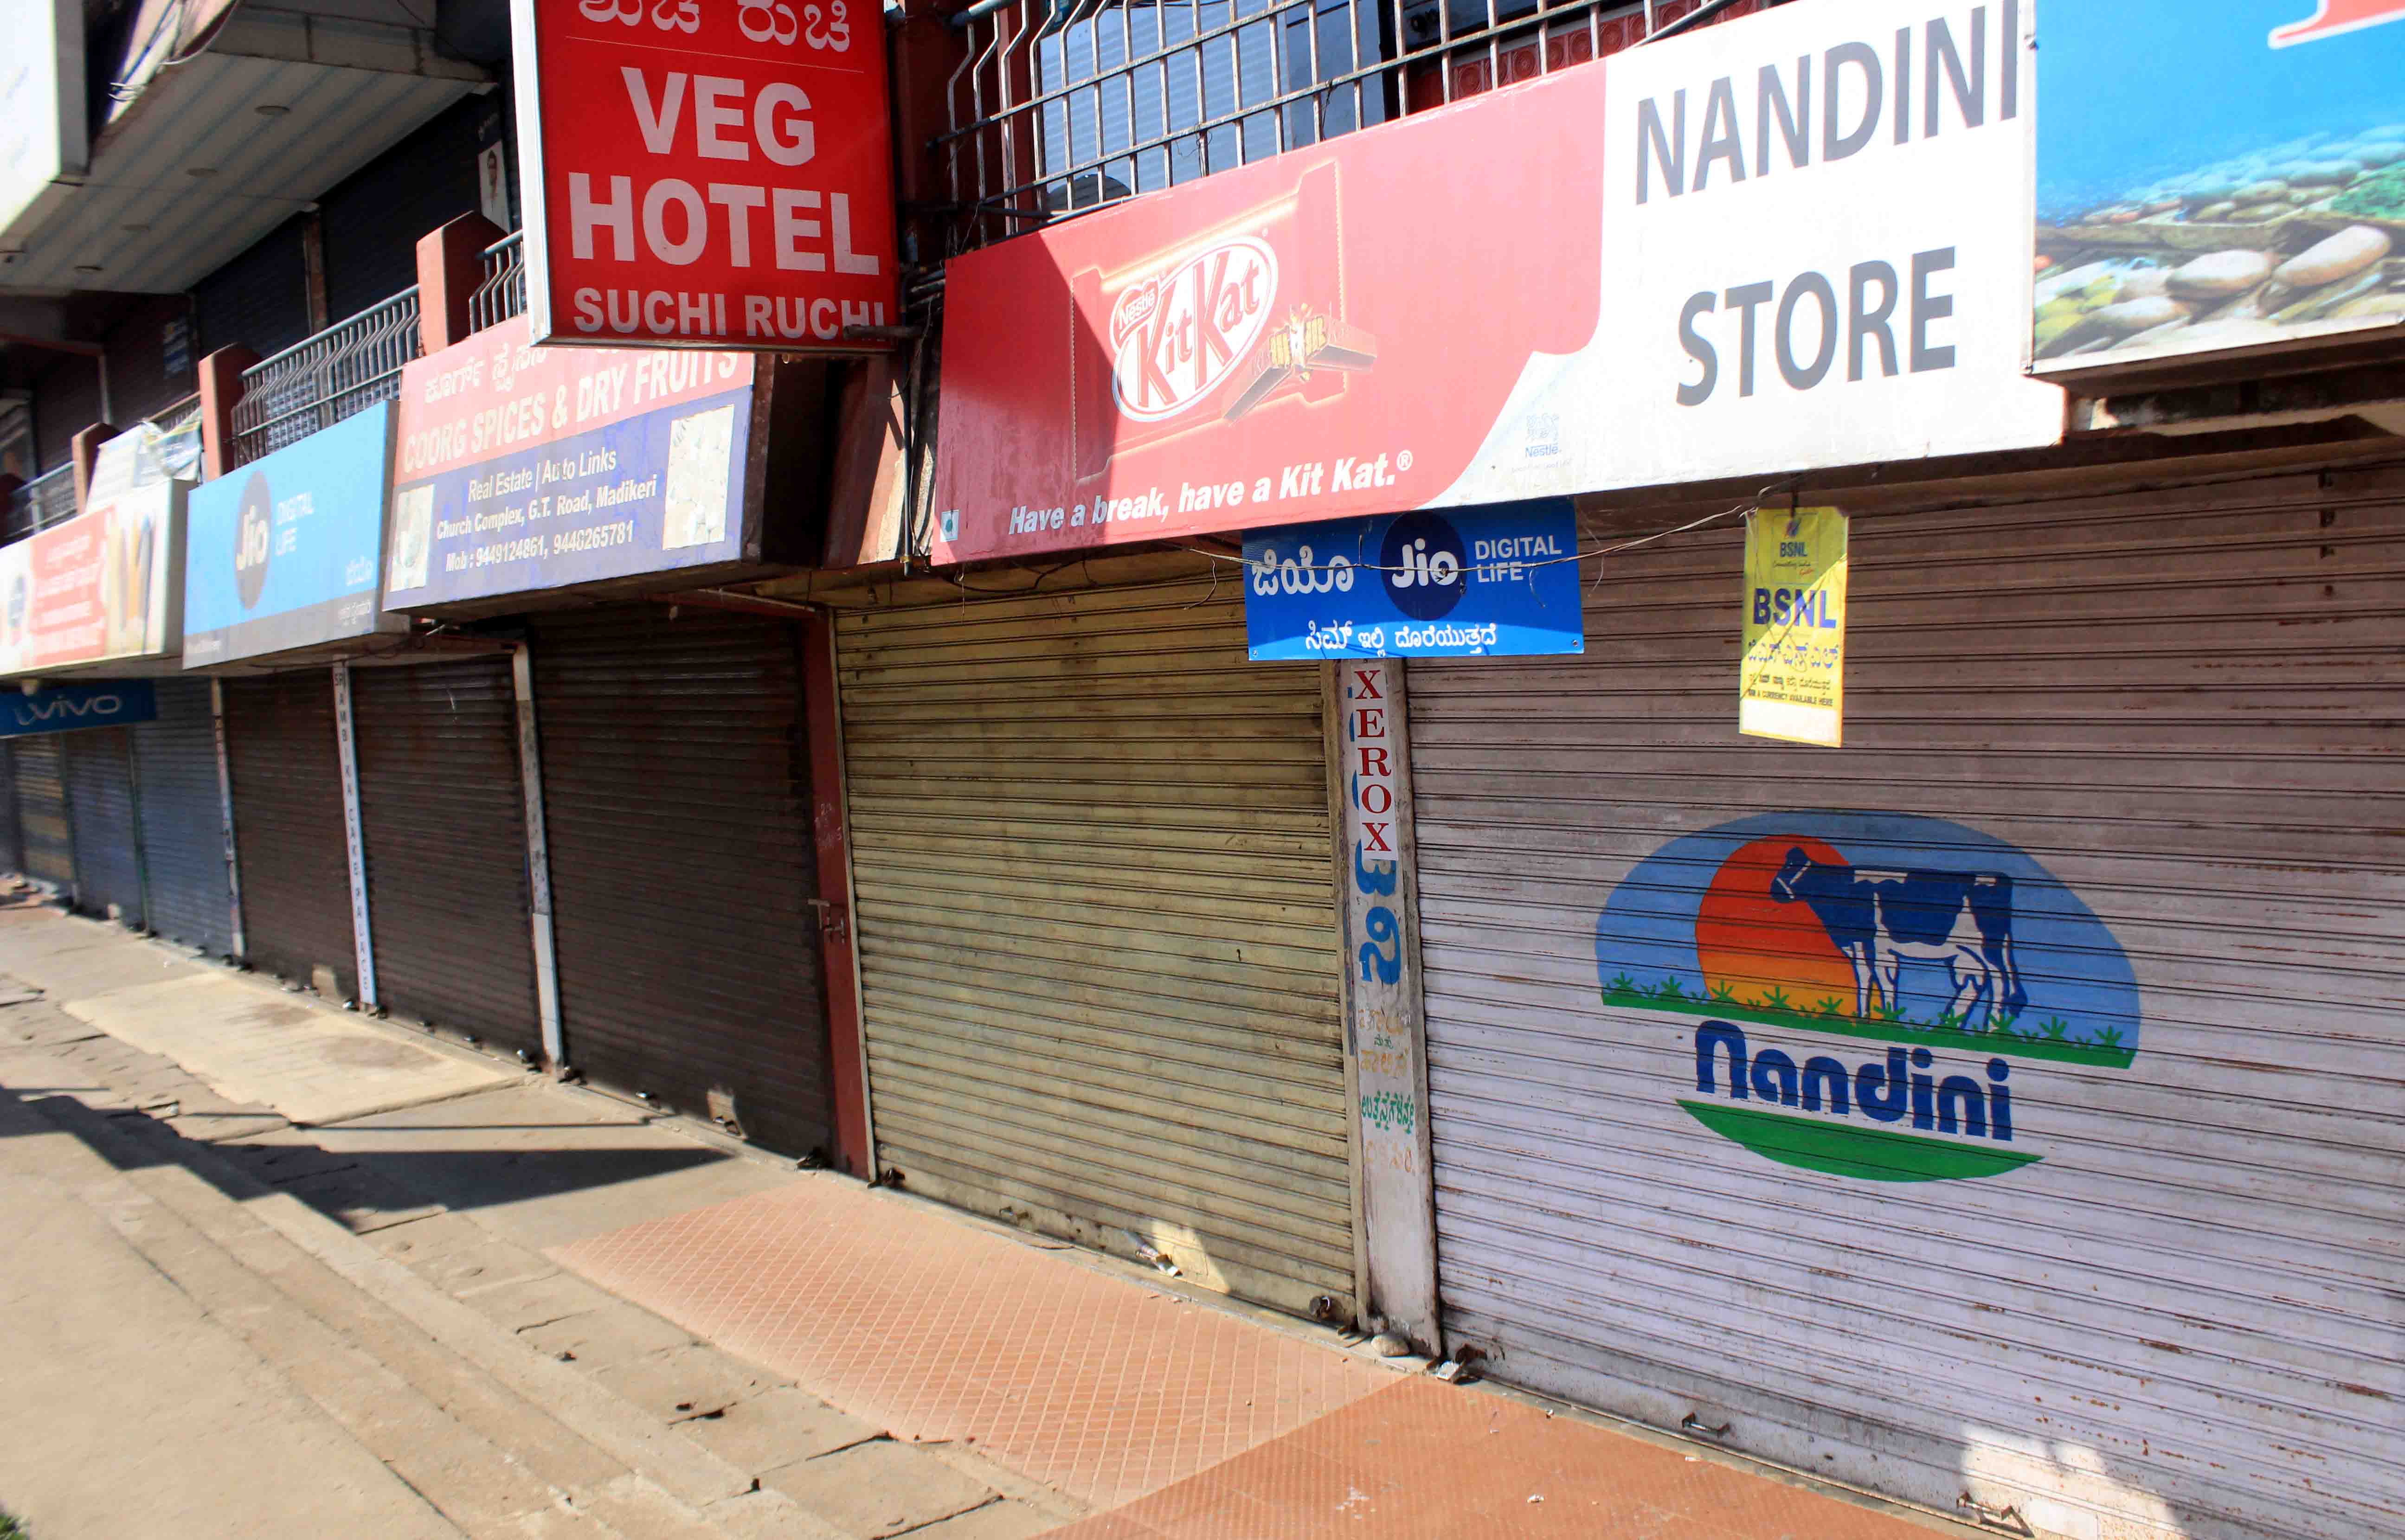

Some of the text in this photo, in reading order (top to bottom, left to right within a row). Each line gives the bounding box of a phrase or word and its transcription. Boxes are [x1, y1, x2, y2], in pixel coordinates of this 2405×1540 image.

[620, 66, 816, 167] VEG
[1635, 0, 2018, 205] NANDINI
[568, 172, 879, 276] HOTEL
[574, 287, 886, 342] SUCHI RUCHI
[1676, 246, 1956, 407] STORE
[404, 419, 466, 474] COORG
[471, 392, 547, 454] SPICES
[552, 385, 568, 429] &
[576, 363, 628, 423] DRY
[437, 475, 657, 539] Church Complex, G.T. Road, Madikeri
[468, 475, 493, 502] Real
[495, 471, 533, 497] Estate
[579, 446, 617, 478] Links
[1009, 506, 1064, 535] Have
[1071, 502, 1086, 524] a
[1092, 487, 1169, 525] break,
[1178, 481, 1245, 513] have
[1253, 477, 1270, 503] a
[1279, 462, 1324, 499] Kit
[236, 504, 268, 571] Jio
[1392, 535, 1562, 589] Jio DIGITAL
[1780, 542, 1808, 557] BSNL
[1477, 561, 1524, 583] LIFE
[1752, 588, 1836, 629] BSNL
[13, 695, 122, 725] vivo
[1354, 670, 1393, 852] XEROX
[1695, 1020, 2012, 1141] Nandini
